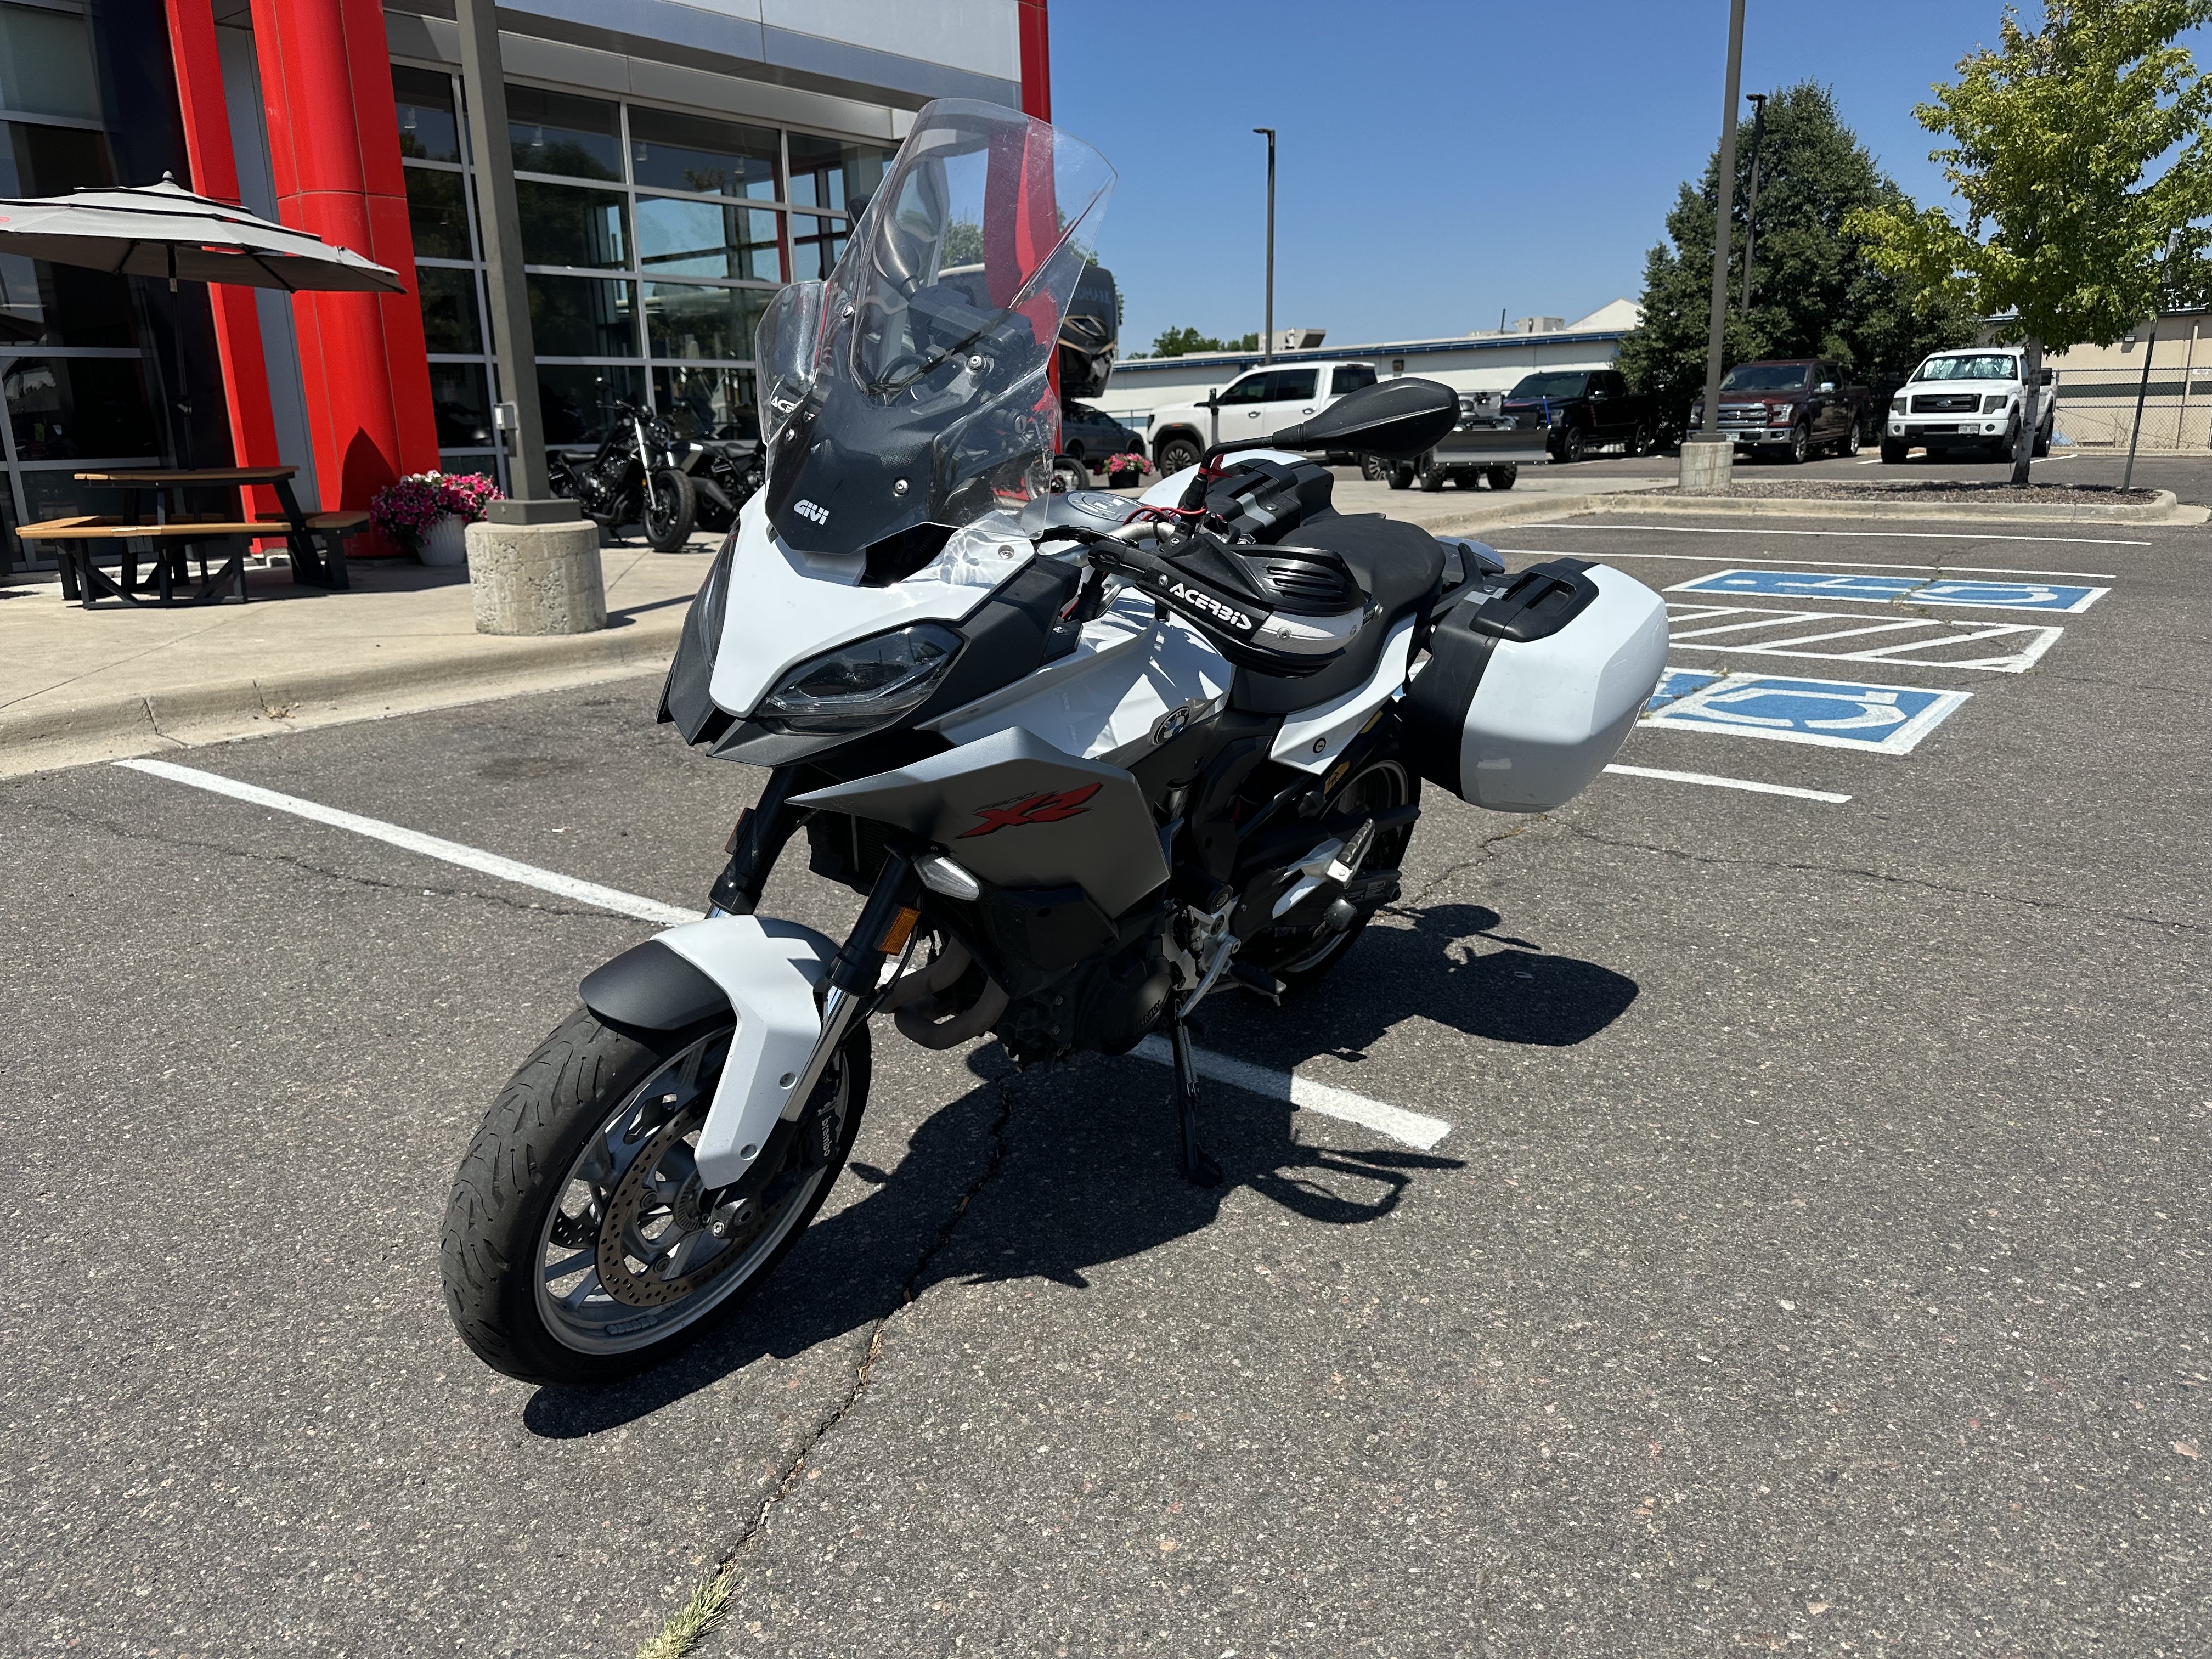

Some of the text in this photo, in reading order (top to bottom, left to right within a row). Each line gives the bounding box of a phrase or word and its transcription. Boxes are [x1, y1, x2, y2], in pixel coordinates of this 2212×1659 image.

[793, 499, 830, 526] GIVI
[1169, 583, 1252, 630] ACERBIS
[953, 782, 1104, 840] XR
[822, 1115, 832, 1157] brembo
